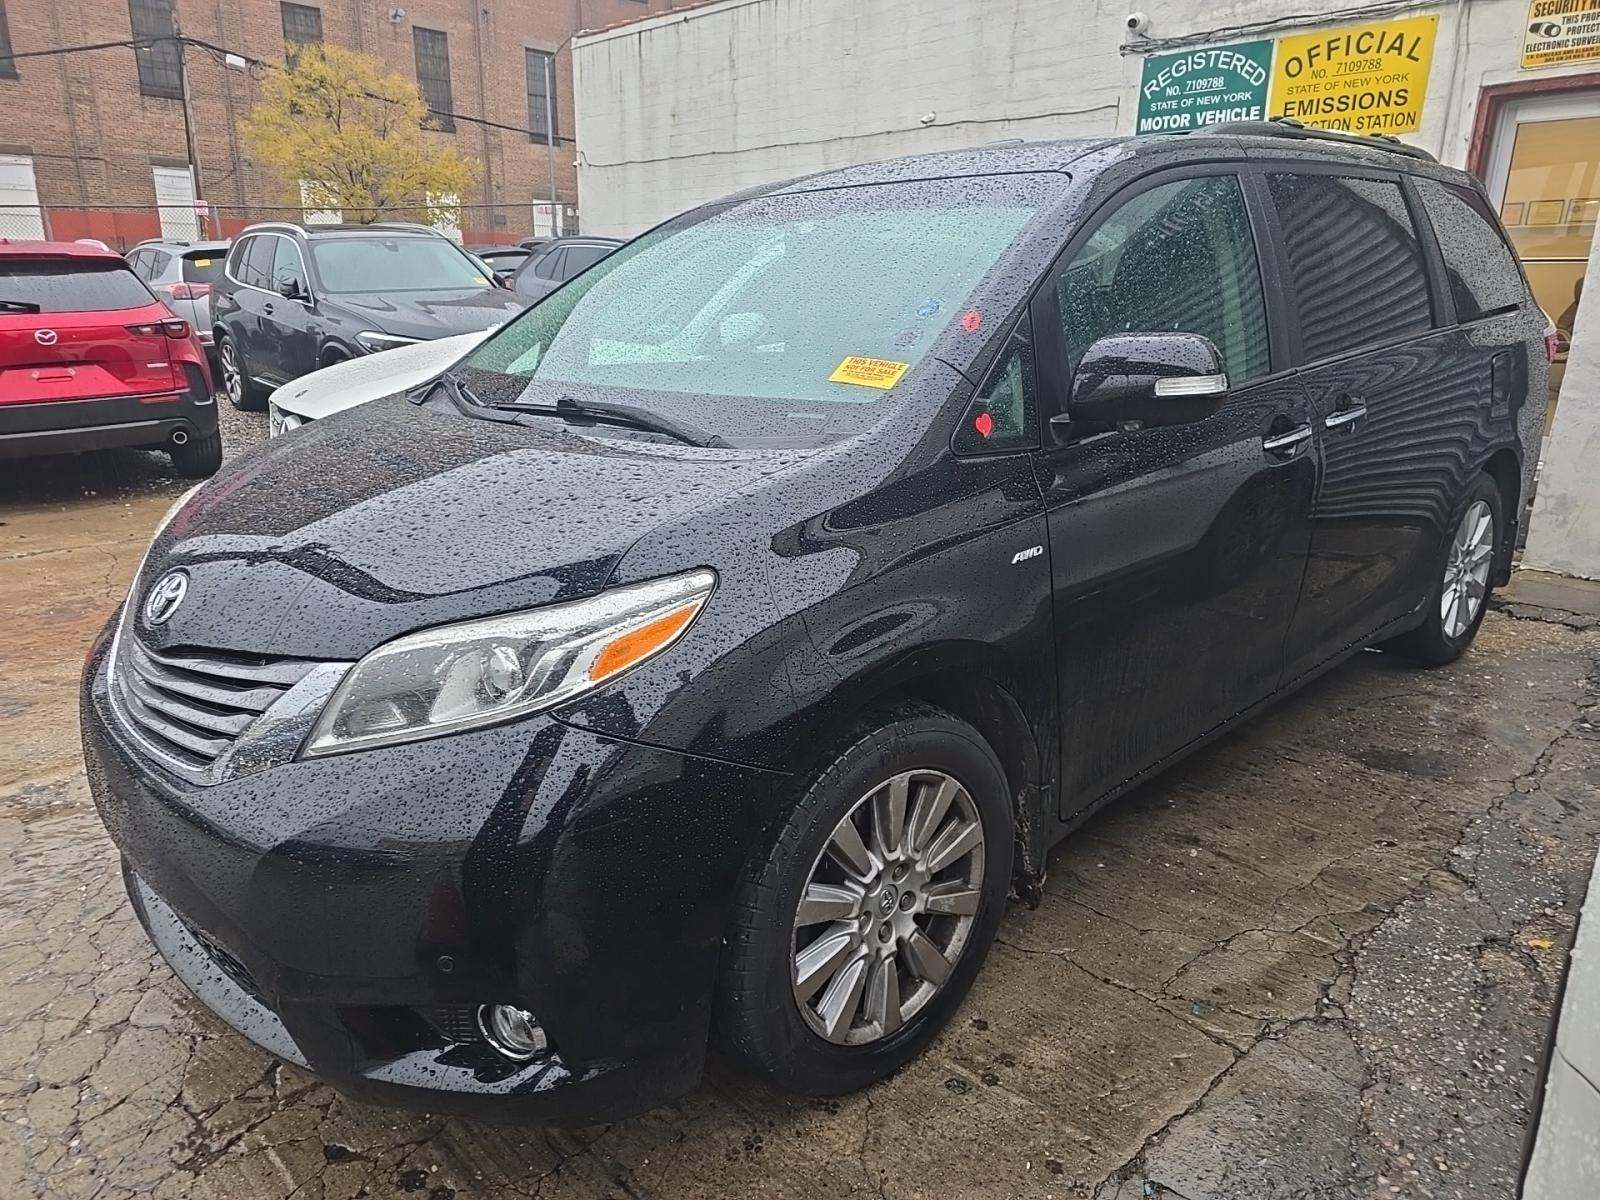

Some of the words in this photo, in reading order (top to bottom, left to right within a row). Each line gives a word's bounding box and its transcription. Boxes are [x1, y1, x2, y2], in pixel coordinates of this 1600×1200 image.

[1534, 0, 1588, 17] SECURITY
[1562, 15, 1579, 25] THIS
[1284, 31, 1422, 78] OFFICIAL
[1526, 39, 1570, 53] ELECTRONIC
[1143, 50, 1267, 99] REGISTERED
[1311, 69, 1328, 80] NO.
[1336, 58, 1382, 74] 7109788
[1165, 85, 1182, 97] NO.
[1186, 76, 1224, 92] 7109788
[1287, 82, 1321, 96] STATE
[1324, 80, 1341, 91] OF
[1343, 77, 1372, 89] NEW
[1375, 72, 1410, 84] YORK
[1150, 99, 1178, 112] STATE
[1181, 98, 1195, 108] OF
[1197, 94, 1221, 106] NEW
[1223, 91, 1253, 102] YORK
[1283, 88, 1409, 118] EMISSIONS
[1140, 112, 1191, 132] MOTOR
[1196, 105, 1261, 126] VEHICLE
[1356, 111, 1417, 130] STATION
[848, 358, 867, 366] THIS
[868, 359, 903, 370] VEHICLE
[879, 368, 897, 376] SALE
[1011, 545, 1043, 564] AWD
